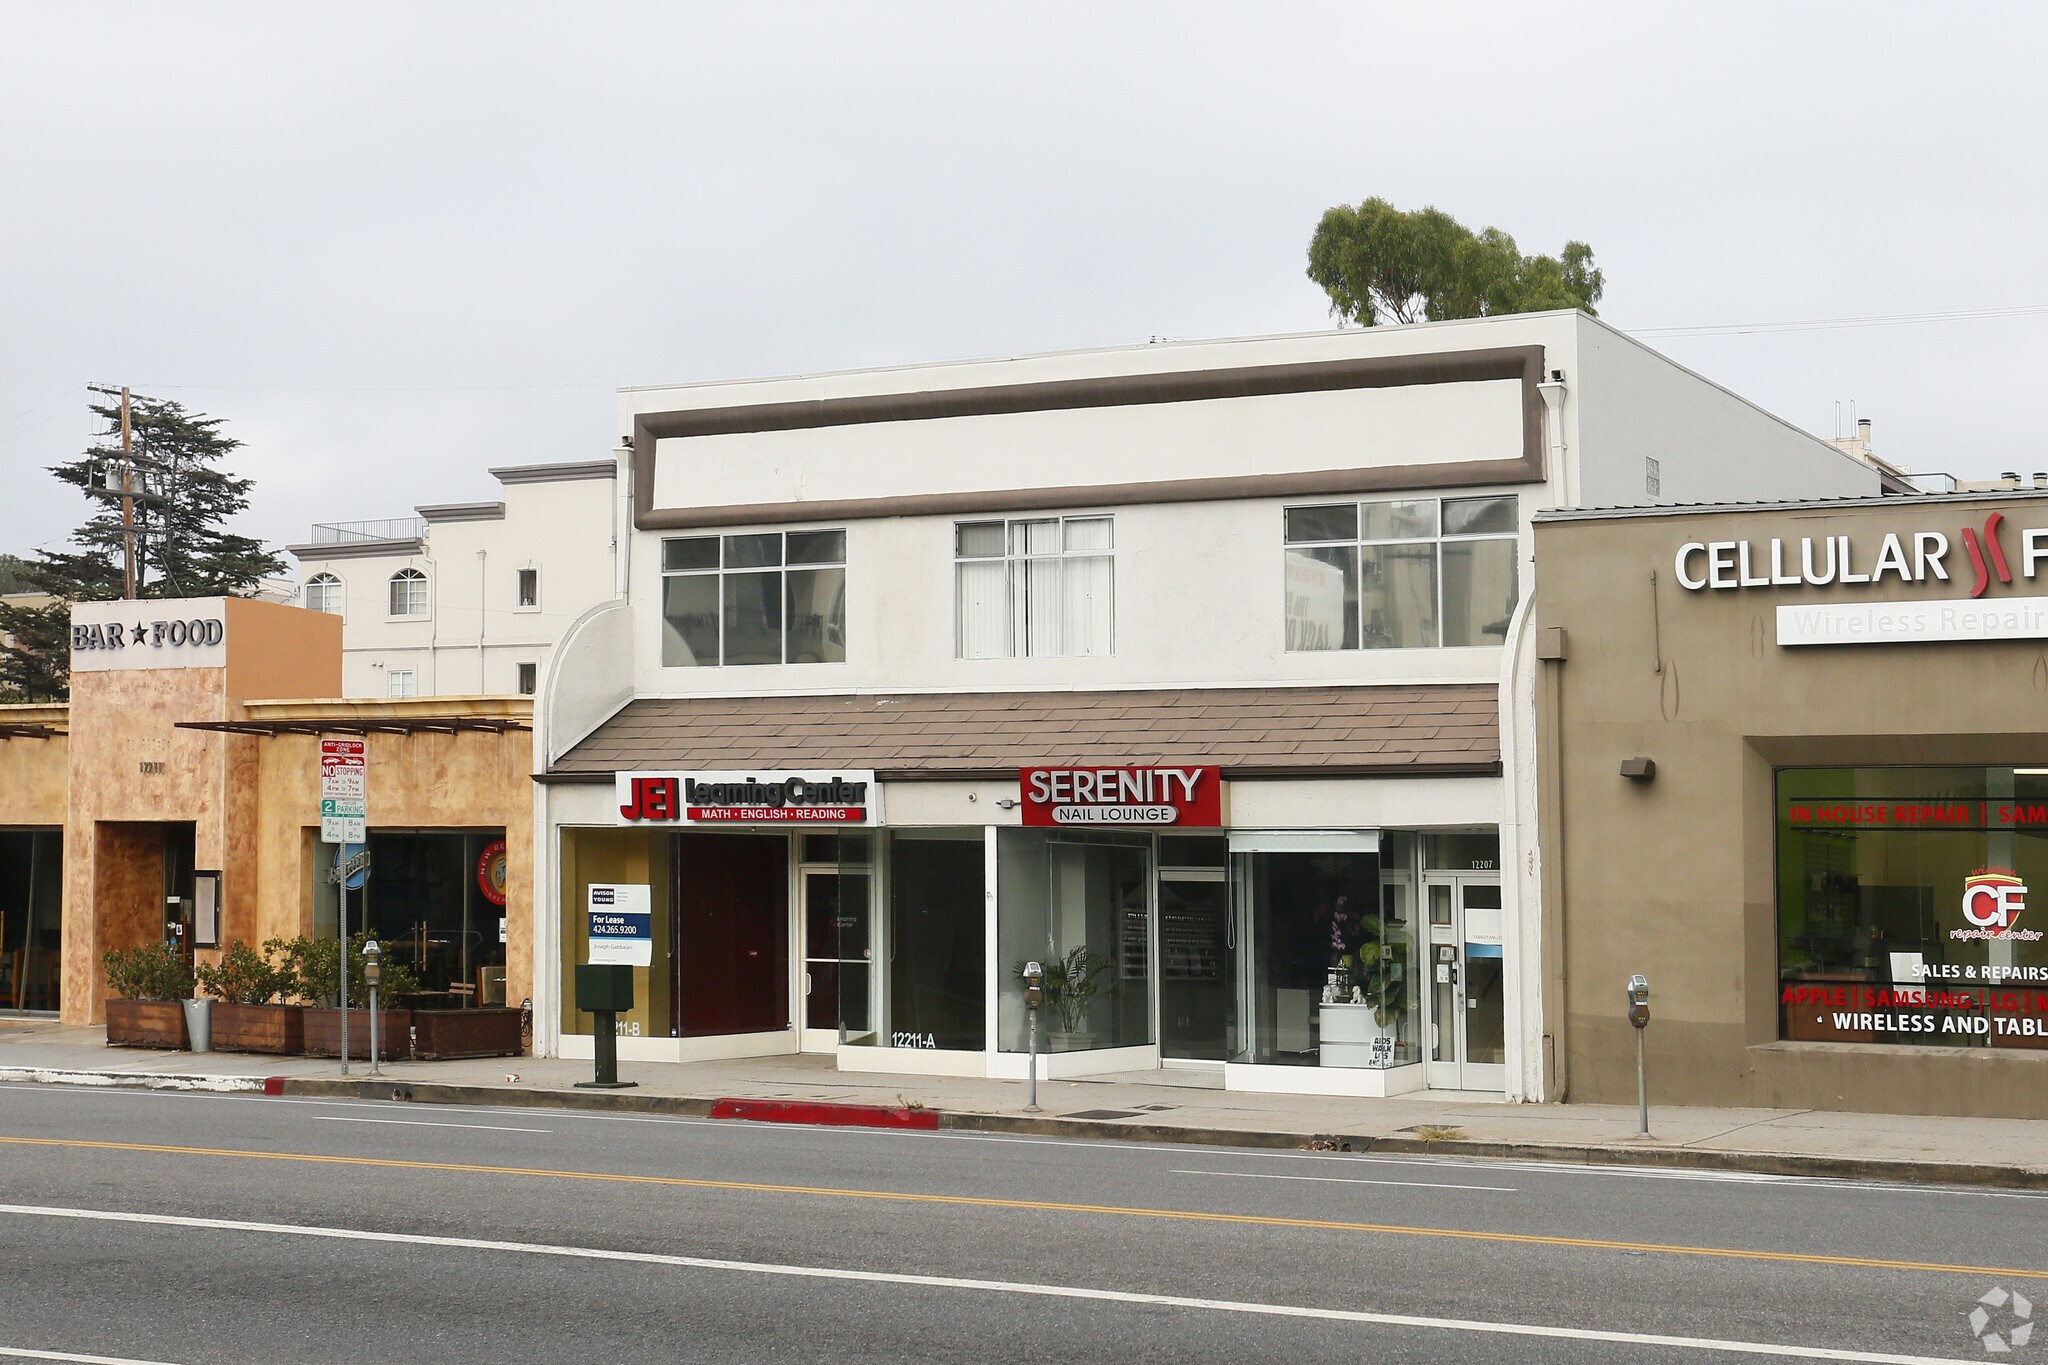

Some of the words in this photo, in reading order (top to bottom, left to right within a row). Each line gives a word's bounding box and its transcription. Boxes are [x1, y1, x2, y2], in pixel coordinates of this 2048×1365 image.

[1674, 531, 1950, 591] CELLULAR
[1793, 608, 1927, 636] Wireless
[1940, 605, 2045, 637] Repair
[71, 623, 125, 650] BAR
[150, 619, 223, 648] FOOD
[322, 765, 335, 777] NO
[336, 767, 364, 777] STOPPING
[684, 776, 786, 808] Learning
[784, 776, 868, 804] Center
[1028, 768, 1203, 804] SERENITY
[324, 801, 333, 812] 2
[619, 777, 680, 822] JEI
[336, 805, 363, 814] PARKING
[701, 808, 731, 819] MATH
[740, 809, 788, 819] ENGLISH
[796, 808, 846, 819] READING
[1059, 808, 1094, 820] NAIL
[1101, 808, 1169, 821] LOUNGE
[1790, 805, 1811, 823] IN
[1817, 805, 1889, 824] HOUSE
[1894, 805, 1969, 823] REPAIR
[1471, 860, 1493, 870] 12207
[1962, 884, 2028, 928] CF
[592, 915, 605, 924] For
[605, 915, 625, 925] Lease
[592, 925, 637, 935] 424.265.9200
[1950, 926, 1995, 942] repair
[1998, 927, 2044, 942] center
[1911, 964, 1960, 979] SALES
[1965, 965, 1977, 979] &
[1981, 965, 2048, 981] REPAIRS
[1781, 985, 1847, 1007] APPLE
[1864, 989, 1972, 1010] SAMSUNG
[1990, 993, 2018, 1011] LG
[1832, 1012, 1936, 1032] WIRELESS
[1941, 1016, 1989, 1035] AND
[892, 1031, 936, 1048] 12211-A
